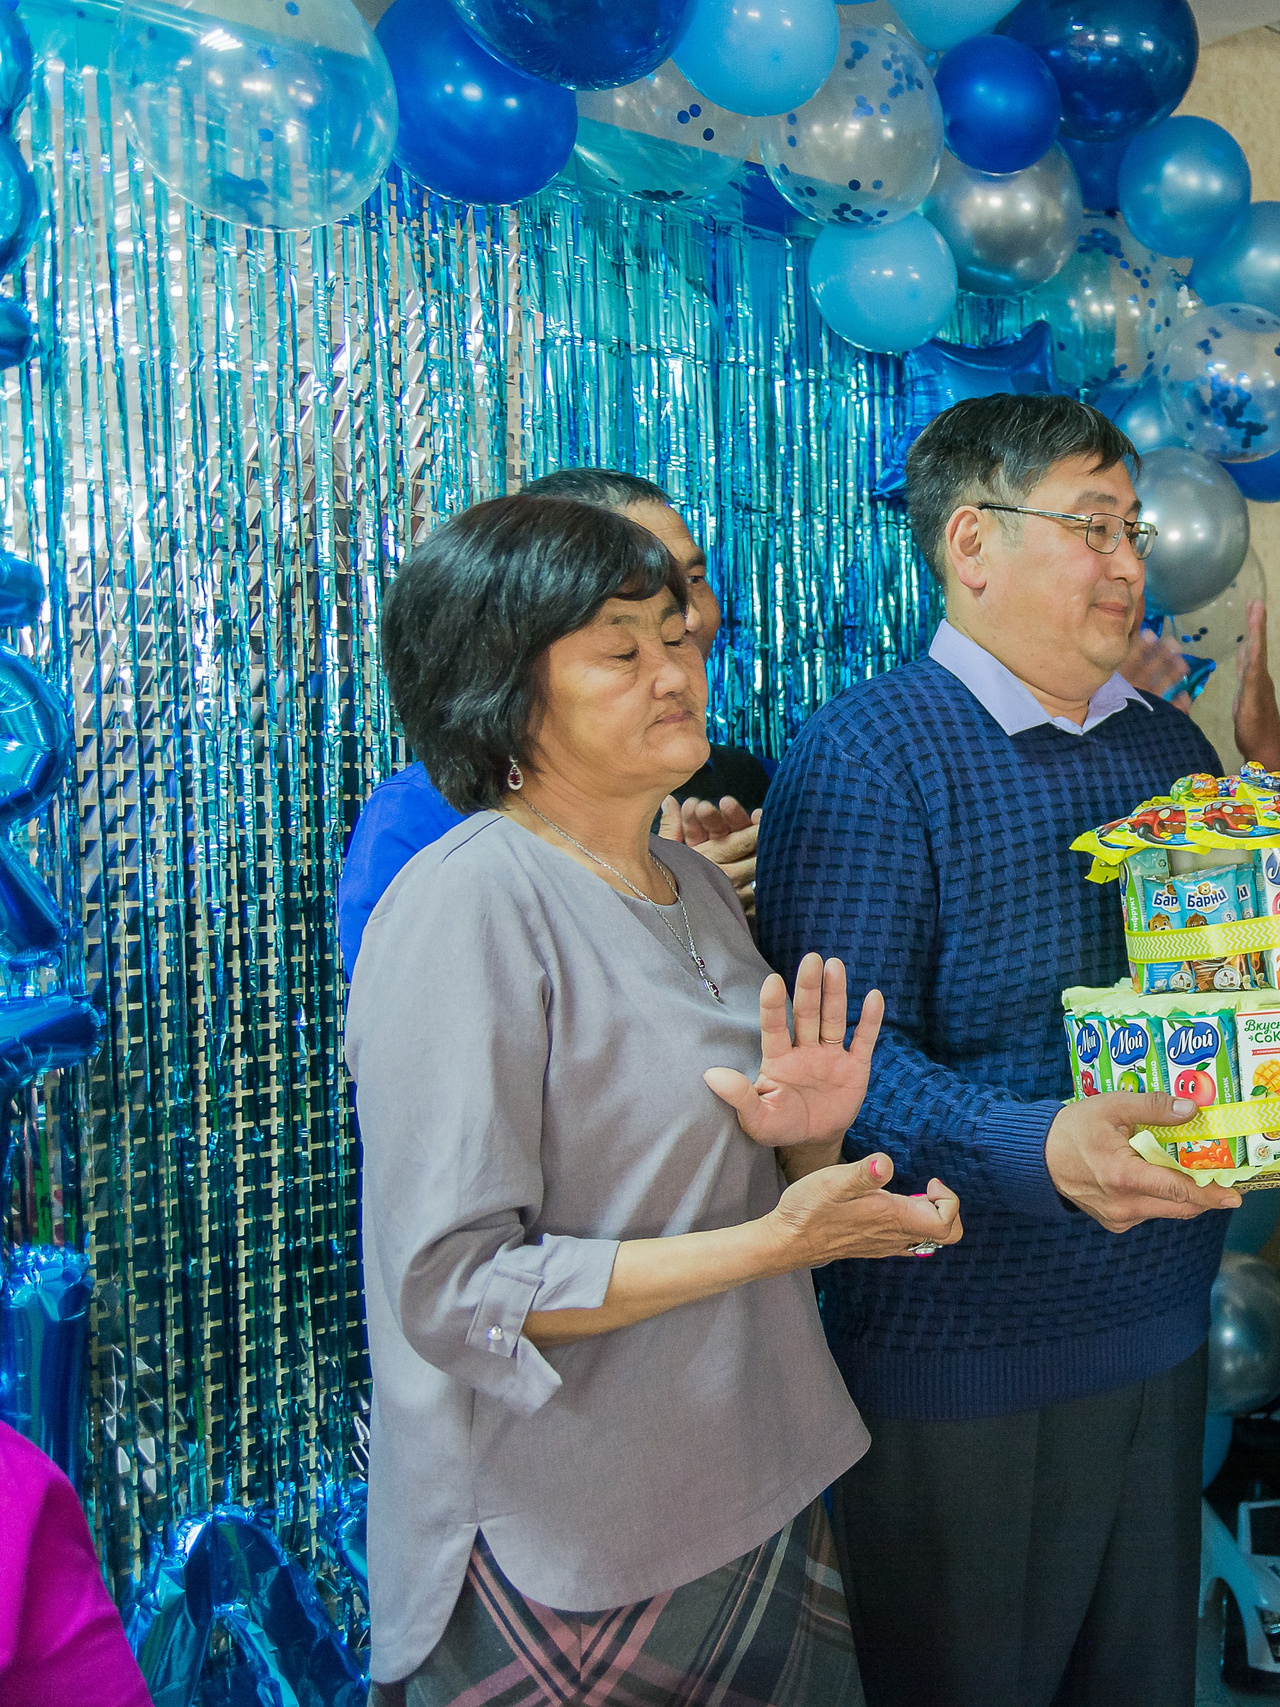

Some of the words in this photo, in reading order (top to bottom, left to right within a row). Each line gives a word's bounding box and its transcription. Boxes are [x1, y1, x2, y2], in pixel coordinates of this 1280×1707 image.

[1186, 889, 1229, 908] Барни
[1078, 1028, 1097, 1057] Мой
[1111, 1028, 1144, 1059] Мой
[1169, 1028, 1214, 1060] Мой
